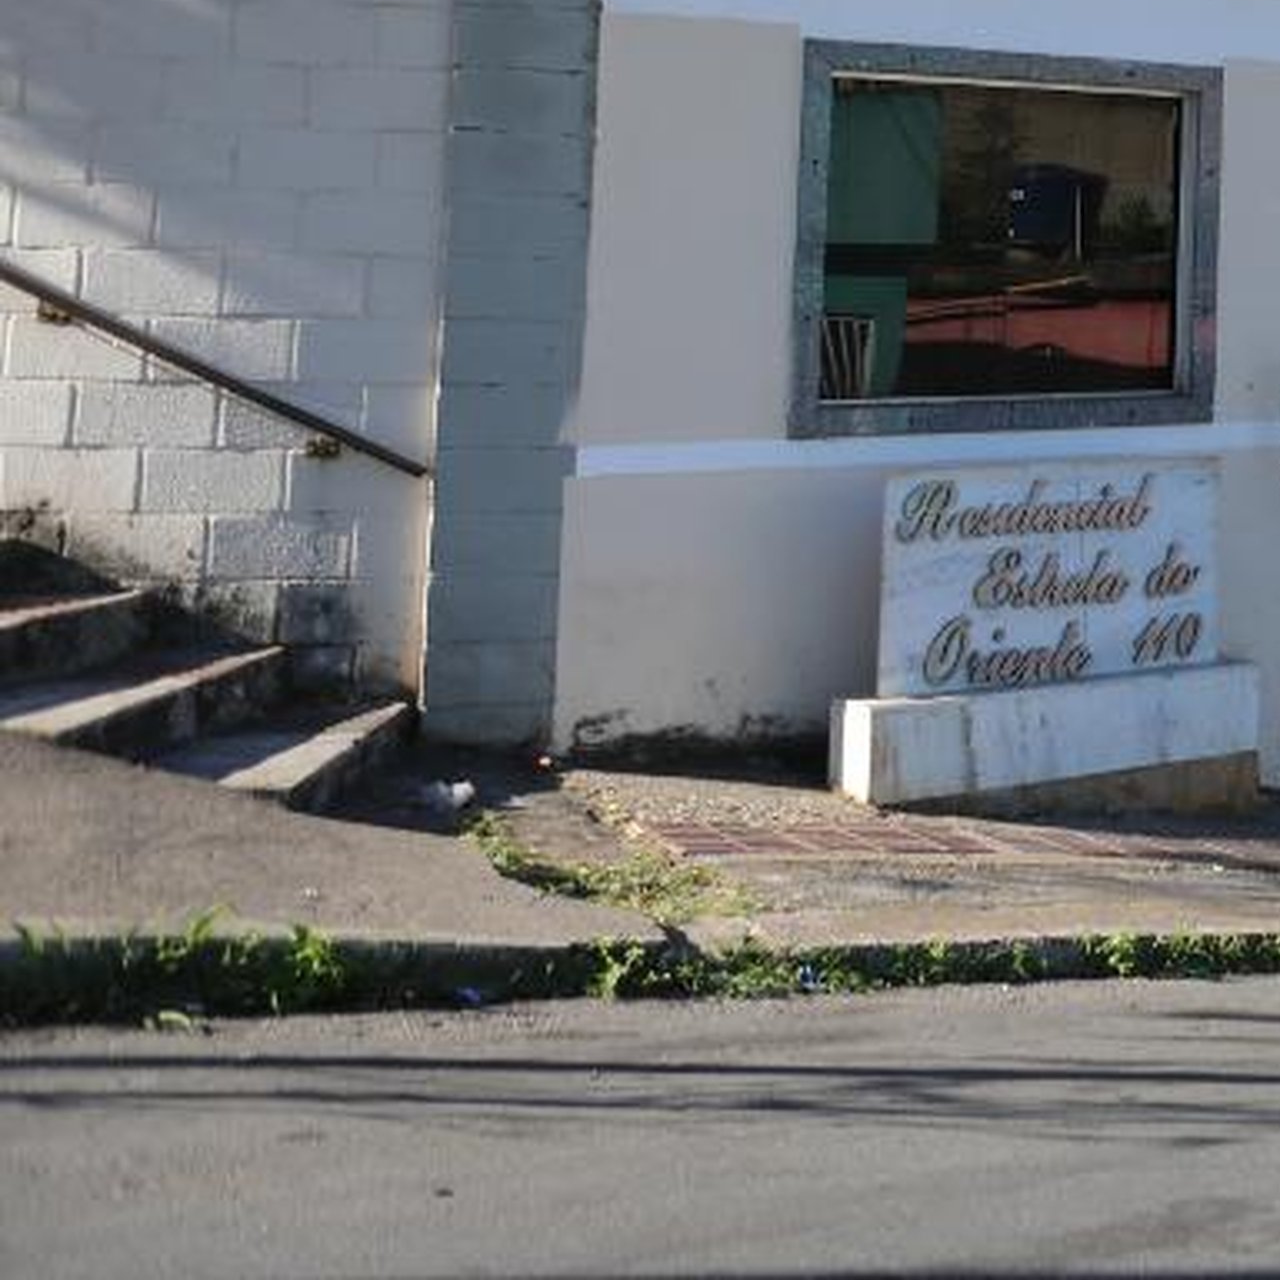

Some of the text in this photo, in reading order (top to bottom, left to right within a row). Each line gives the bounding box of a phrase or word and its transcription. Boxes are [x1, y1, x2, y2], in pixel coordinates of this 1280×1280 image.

[896, 474, 1152, 543] Residencial
[972, 541, 1201, 610] Estrela do
[923, 614, 1093, 687] Oriente
